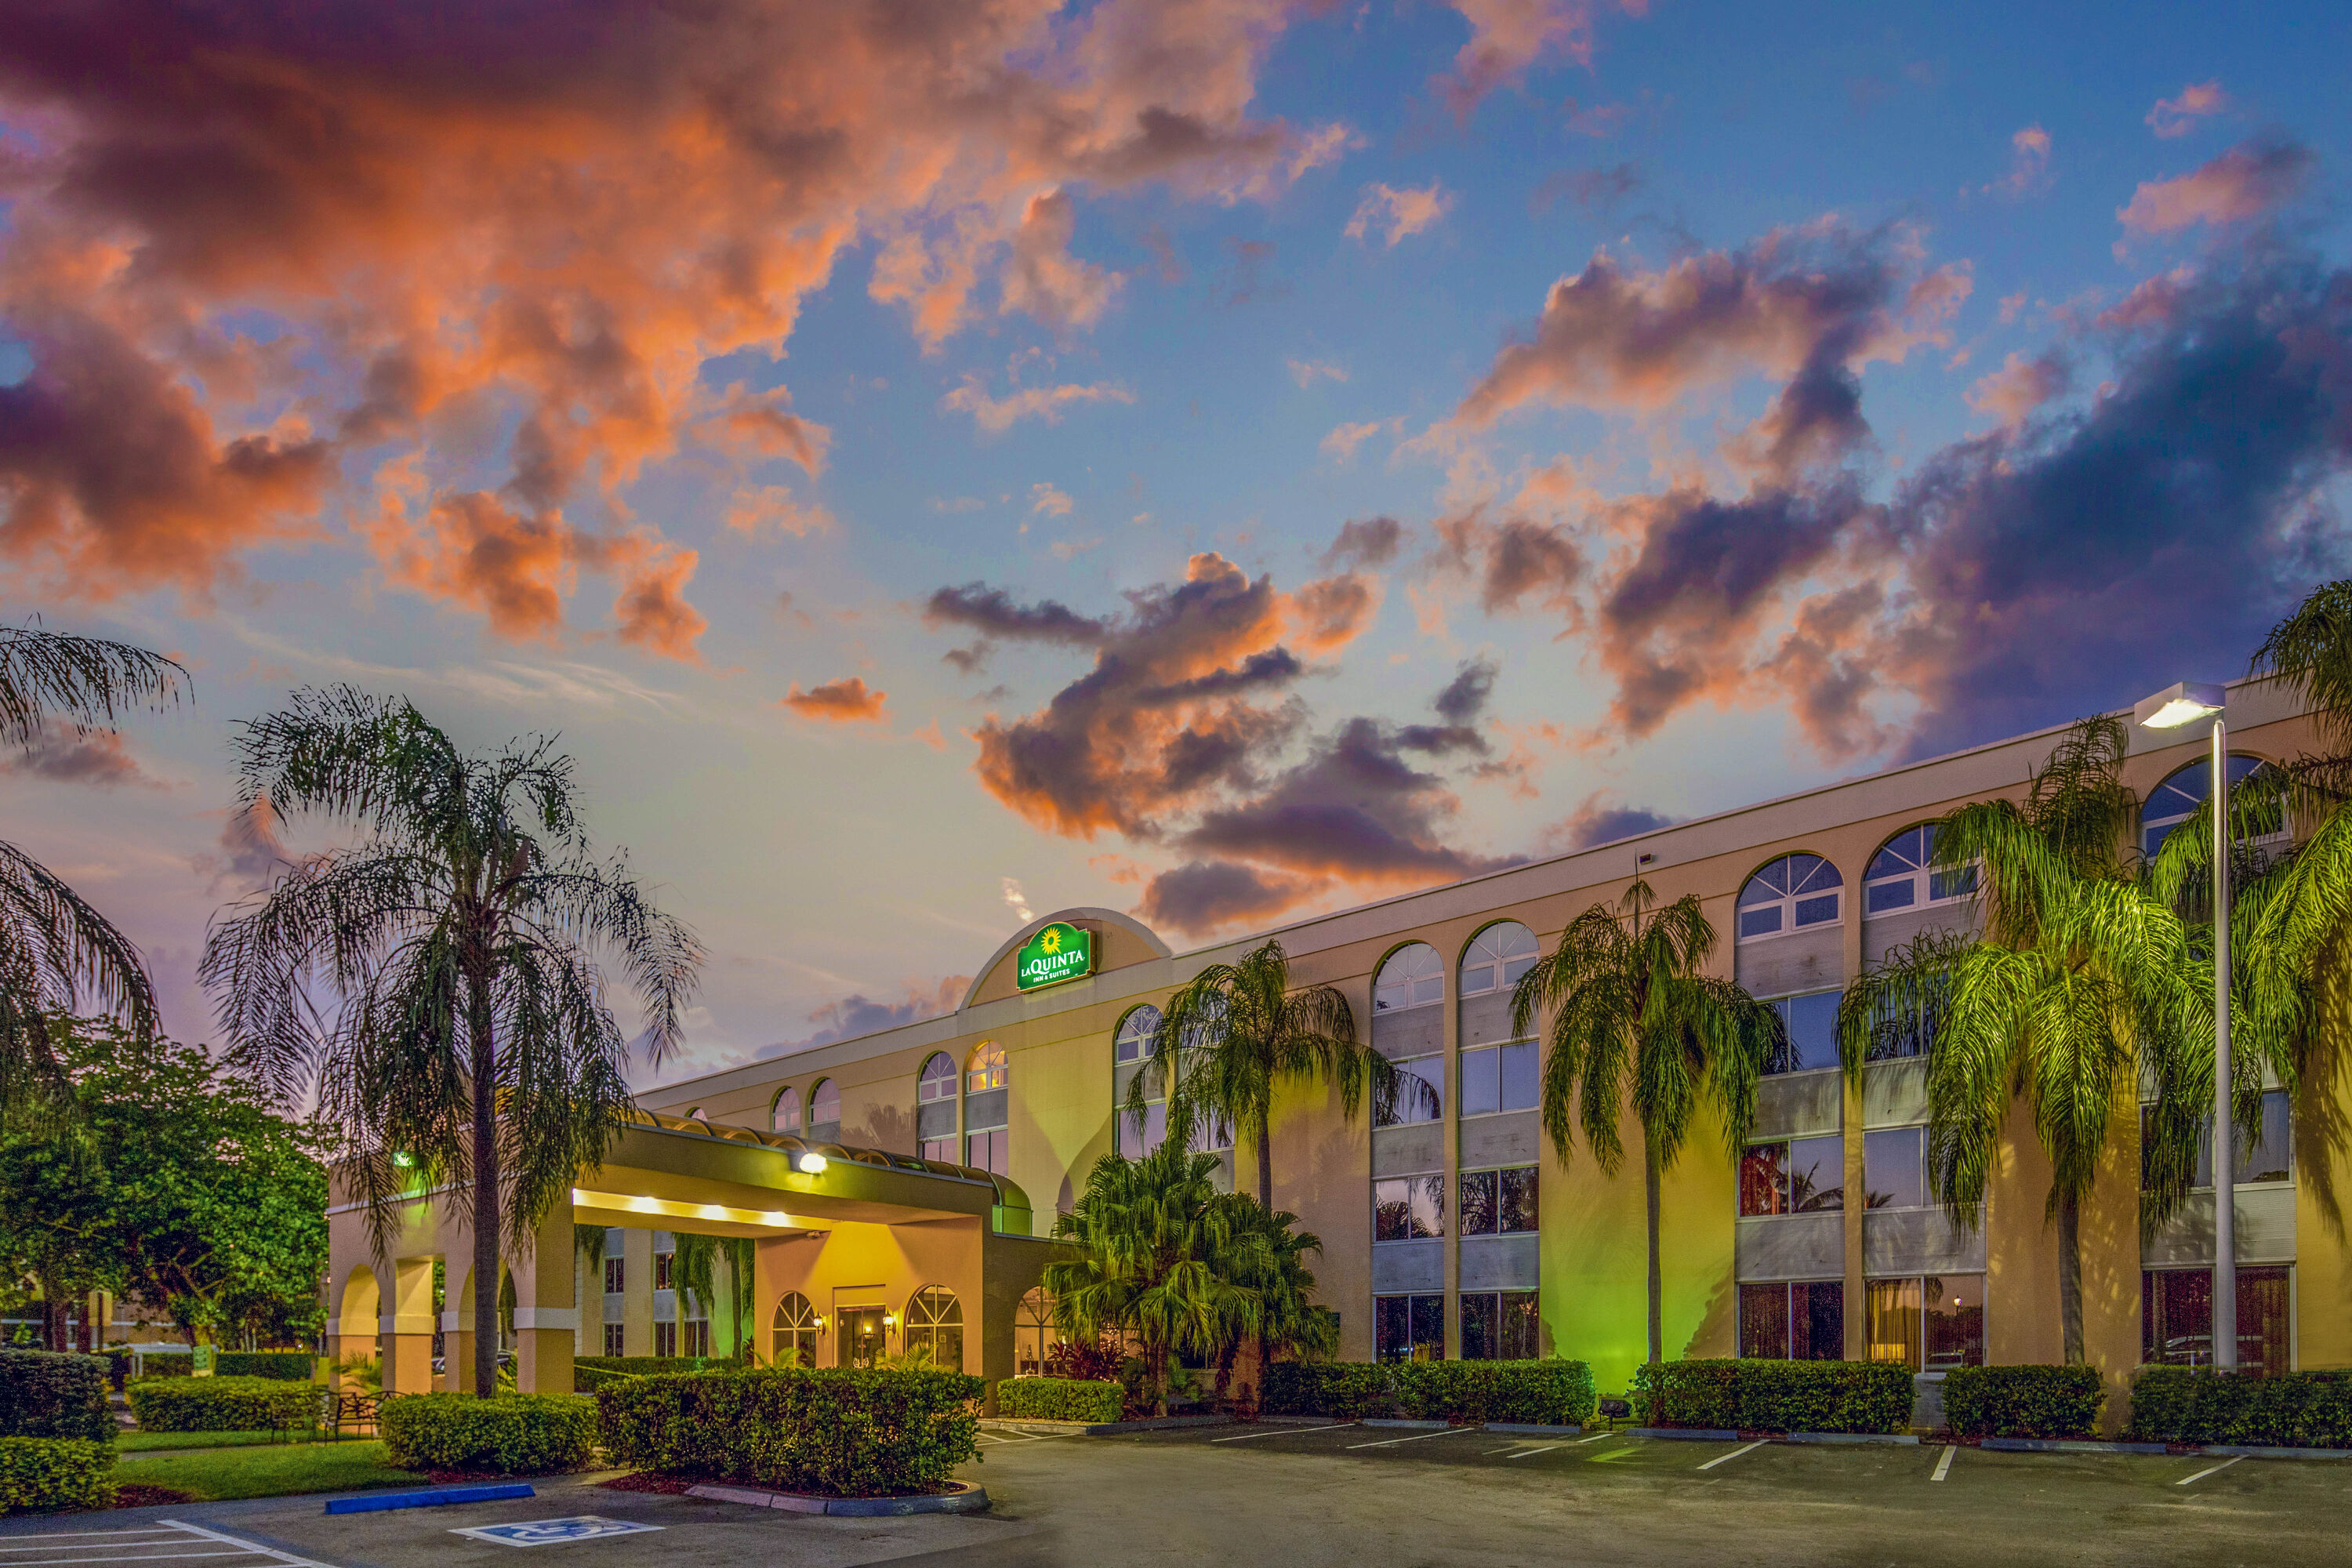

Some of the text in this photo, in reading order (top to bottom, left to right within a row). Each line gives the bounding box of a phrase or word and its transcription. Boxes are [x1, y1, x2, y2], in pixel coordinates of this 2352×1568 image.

[1022, 949, 1083, 977] LA QUINTA
[1049, 968, 1070, 978] SUITES
